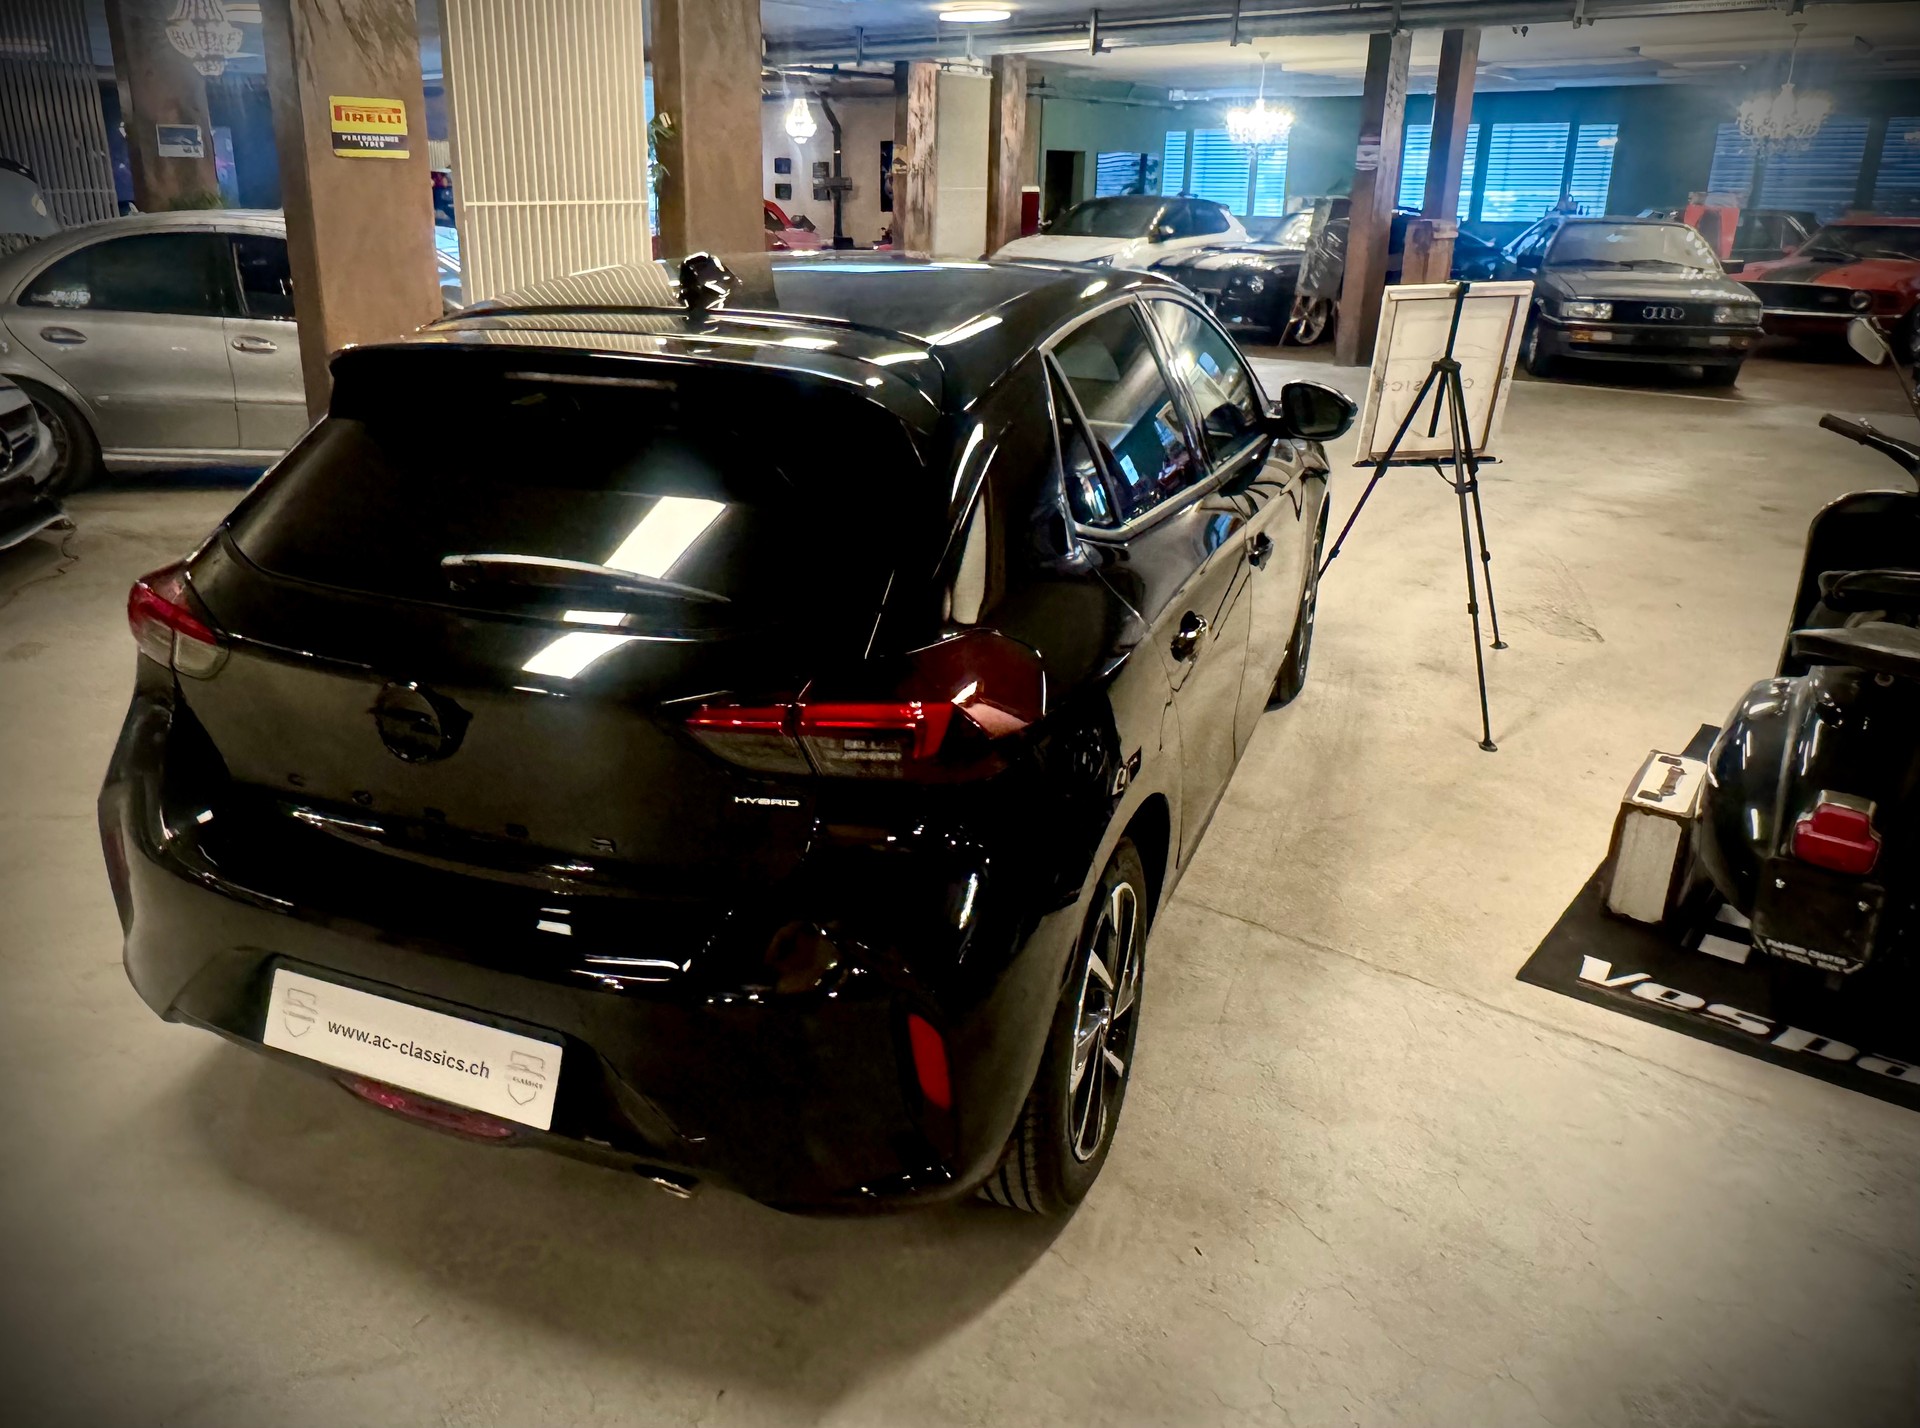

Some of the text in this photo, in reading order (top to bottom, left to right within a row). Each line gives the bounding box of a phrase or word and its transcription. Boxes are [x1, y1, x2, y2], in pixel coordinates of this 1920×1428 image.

[333, 105, 402, 124] PIRELLI
[734, 796, 800, 807] HYBRID
[327, 1020, 491, 1079] www.ac-classics.ch
